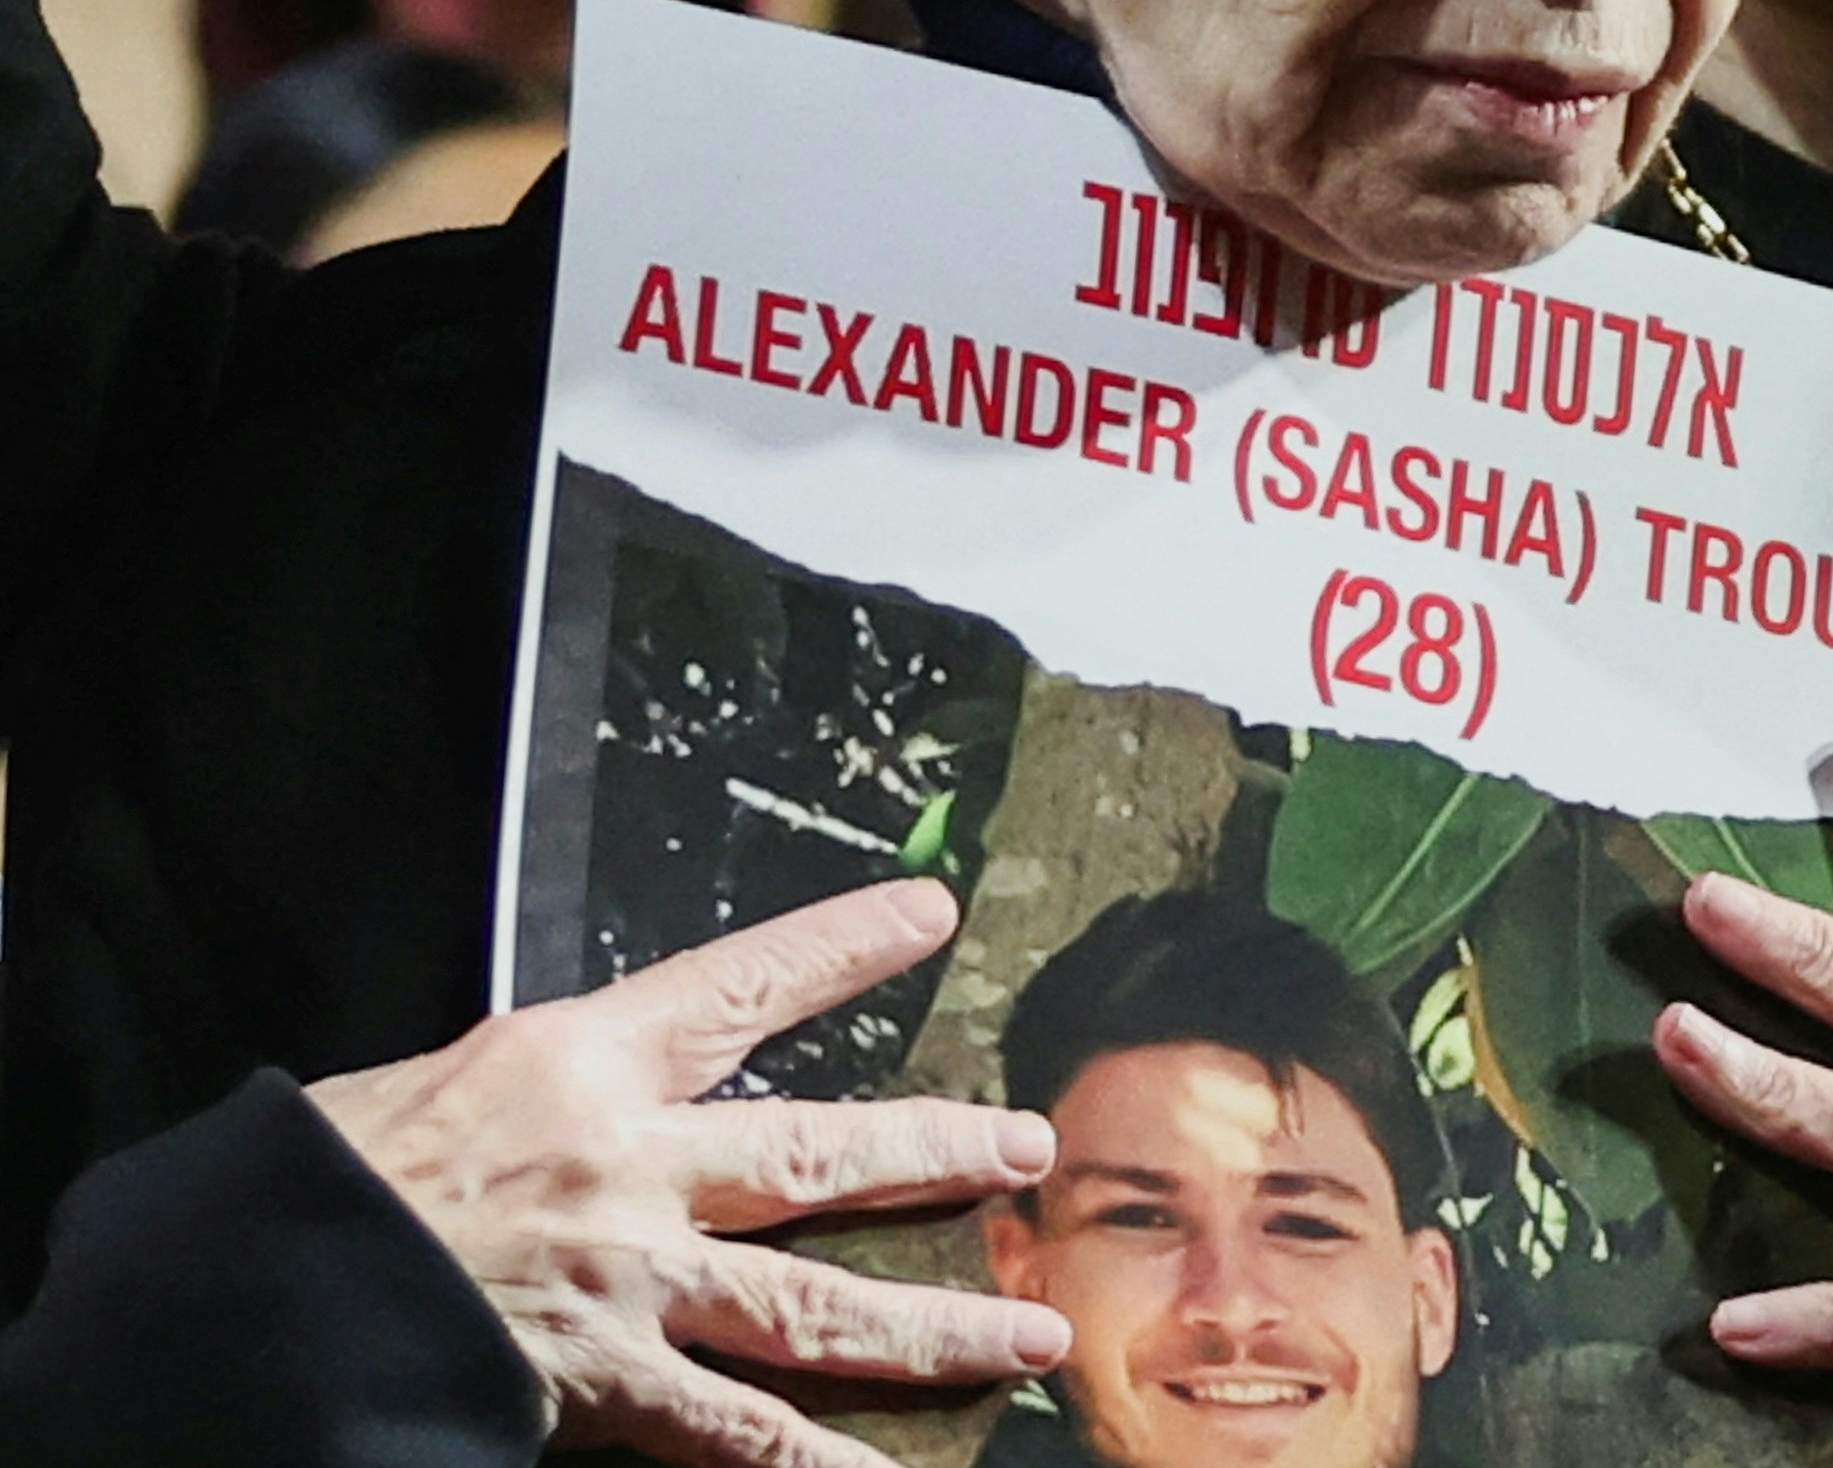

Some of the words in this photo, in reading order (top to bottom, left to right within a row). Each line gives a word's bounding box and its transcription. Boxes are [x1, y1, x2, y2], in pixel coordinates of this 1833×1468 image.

[617, 264, 1196, 482] ALEXANDER
[1233, 409, 1598, 604] (SASHA)
[1309, 569, 1497, 739] (28)
